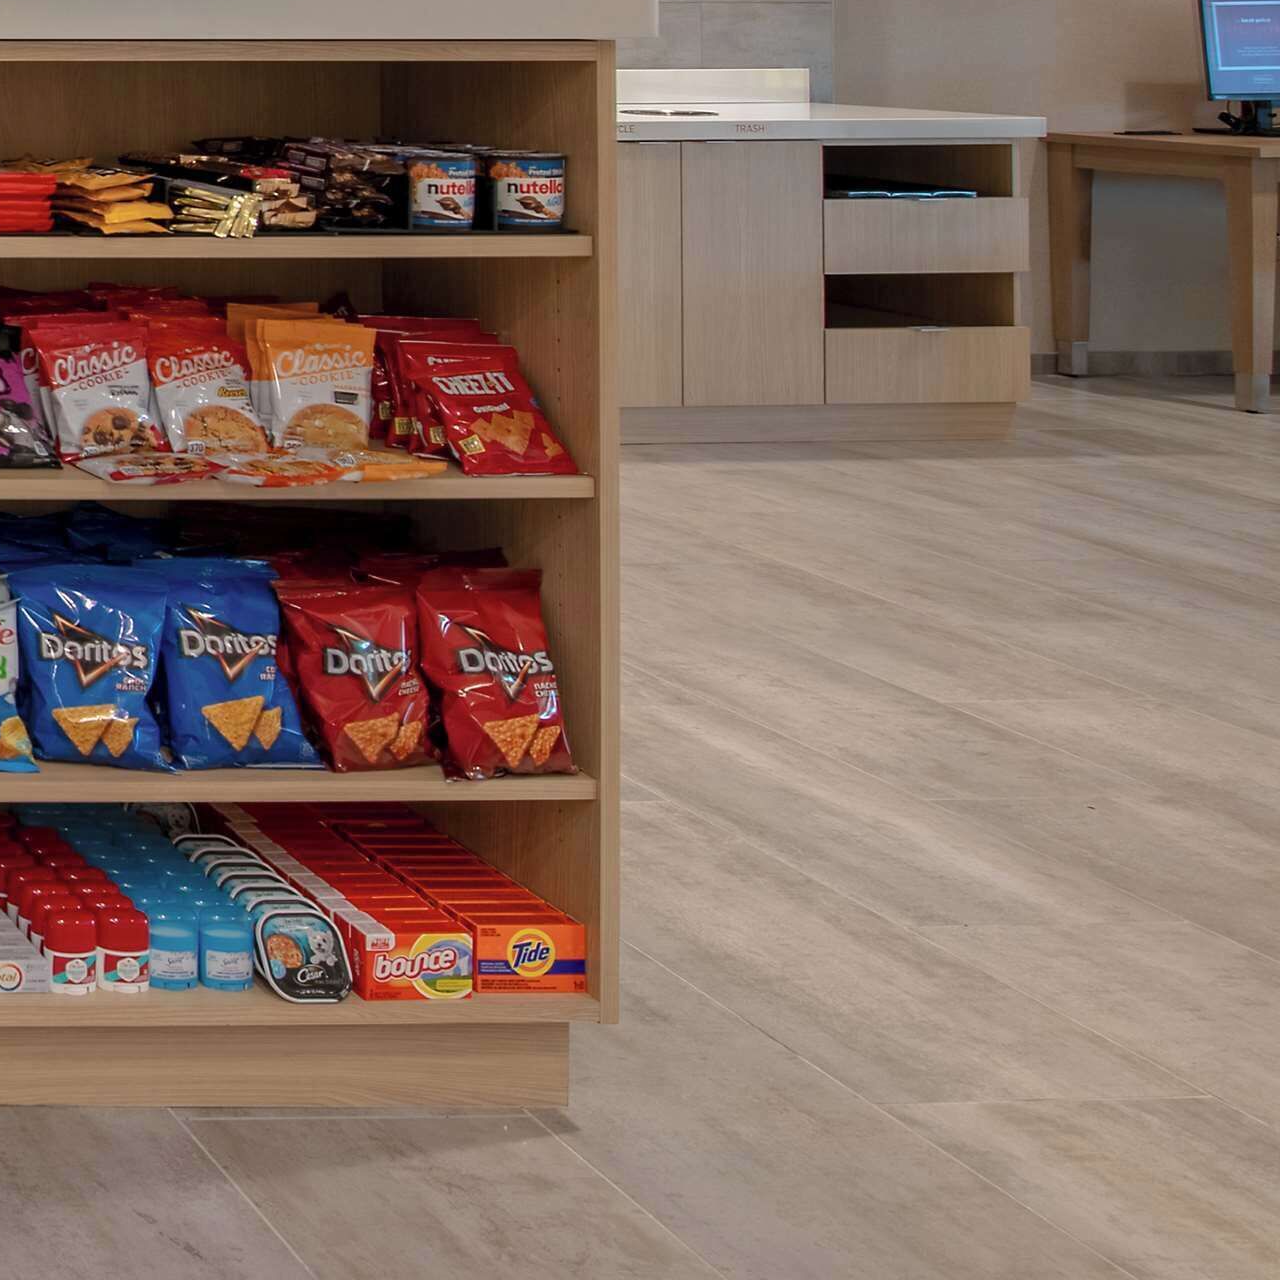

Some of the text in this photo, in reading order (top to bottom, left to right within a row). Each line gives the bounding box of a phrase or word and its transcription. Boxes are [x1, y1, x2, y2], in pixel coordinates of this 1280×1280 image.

[54, 341, 137, 386] Classic
[156, 346, 235, 383] Classic
[276, 344, 366, 377] Classic
[432, 372, 515, 395] CHEEZ-IT
[40, 632, 147, 668] Doritos
[180, 629, 276, 657] Doritos
[459, 648, 554, 674] Doritos
[374, 948, 456, 981] bounce
[512, 941, 550, 968] Tide
